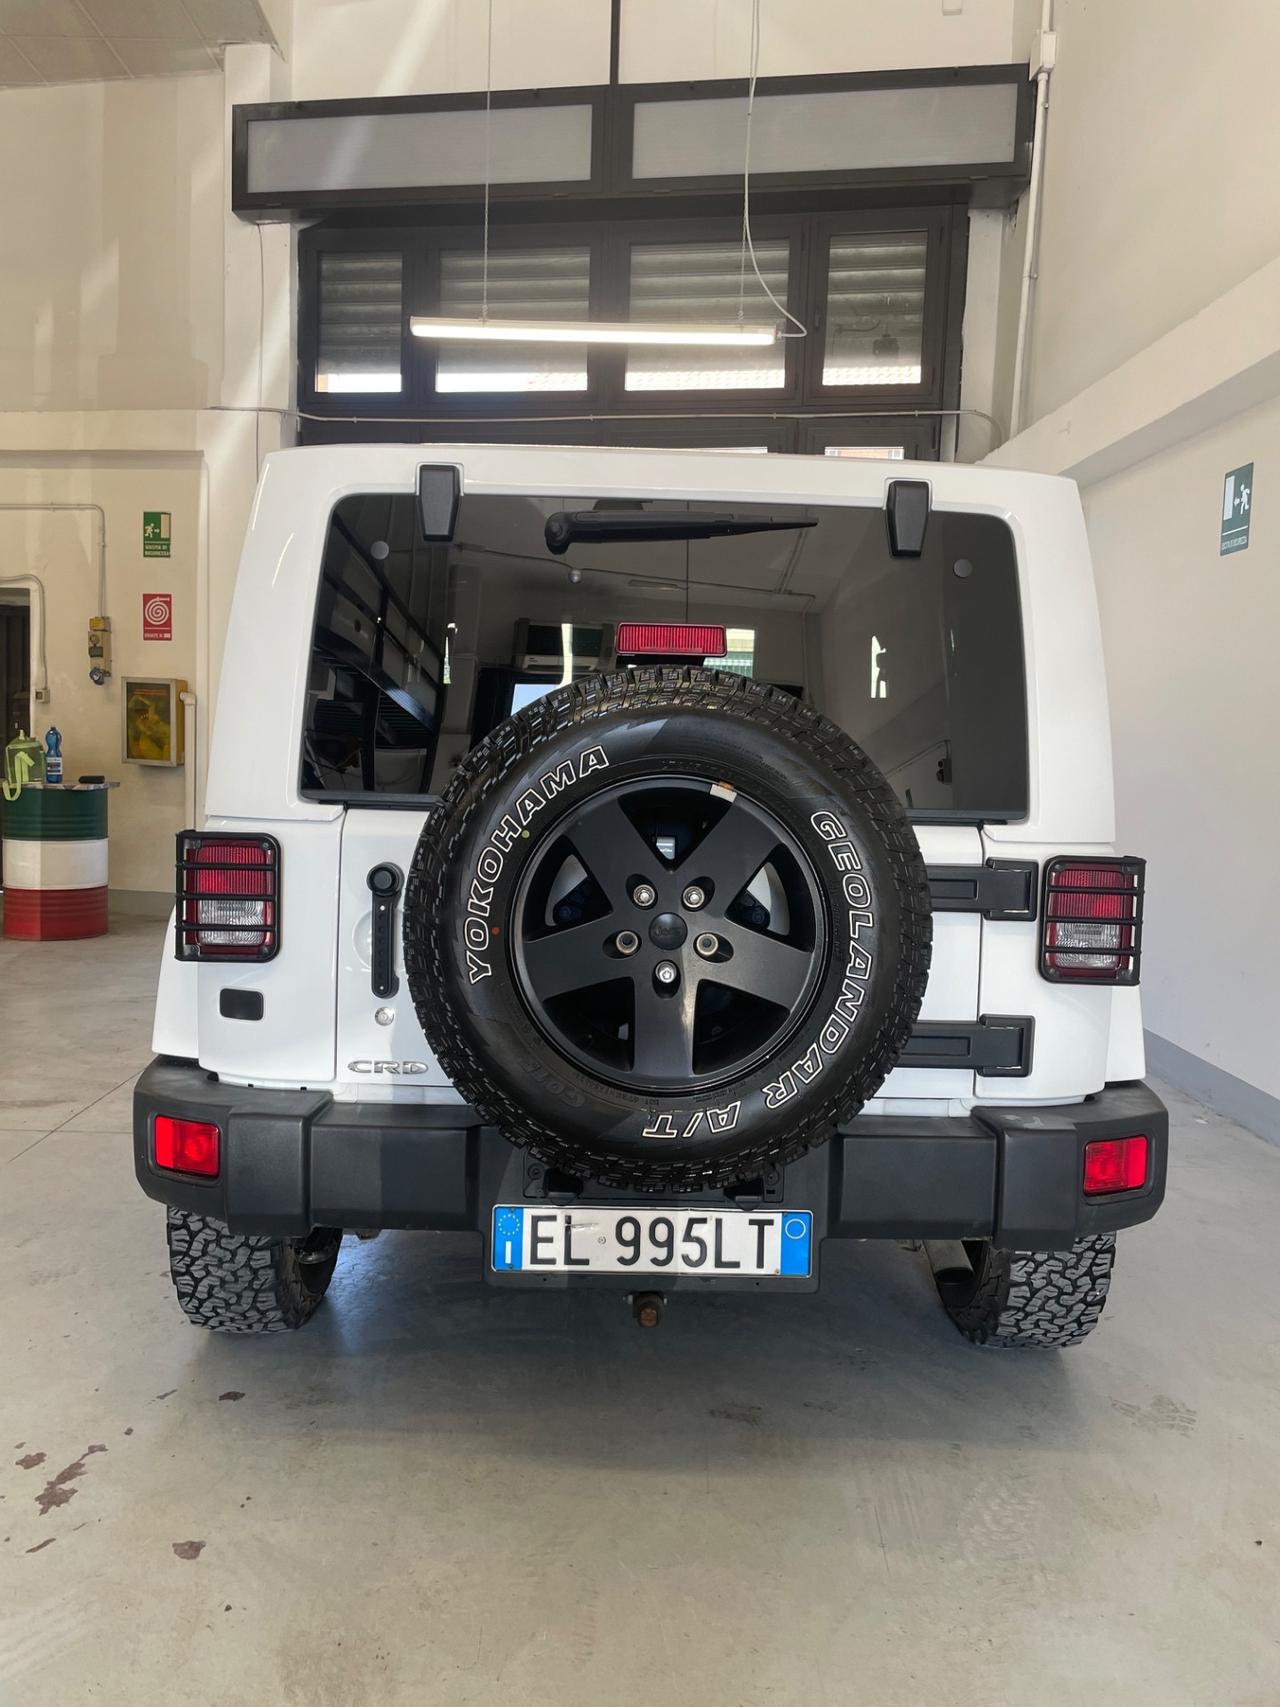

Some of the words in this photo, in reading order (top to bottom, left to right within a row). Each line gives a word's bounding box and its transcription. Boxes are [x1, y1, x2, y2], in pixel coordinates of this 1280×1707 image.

[463, 744, 610, 985] YOKOHAMA
[762, 810, 873, 1111] GEOLANDAR
[347, 1060, 429, 1075] CRD
[642, 1101, 741, 1139] A/T
[529, 1214, 590, 1266] EL
[615, 1215, 775, 1270] 995LT
